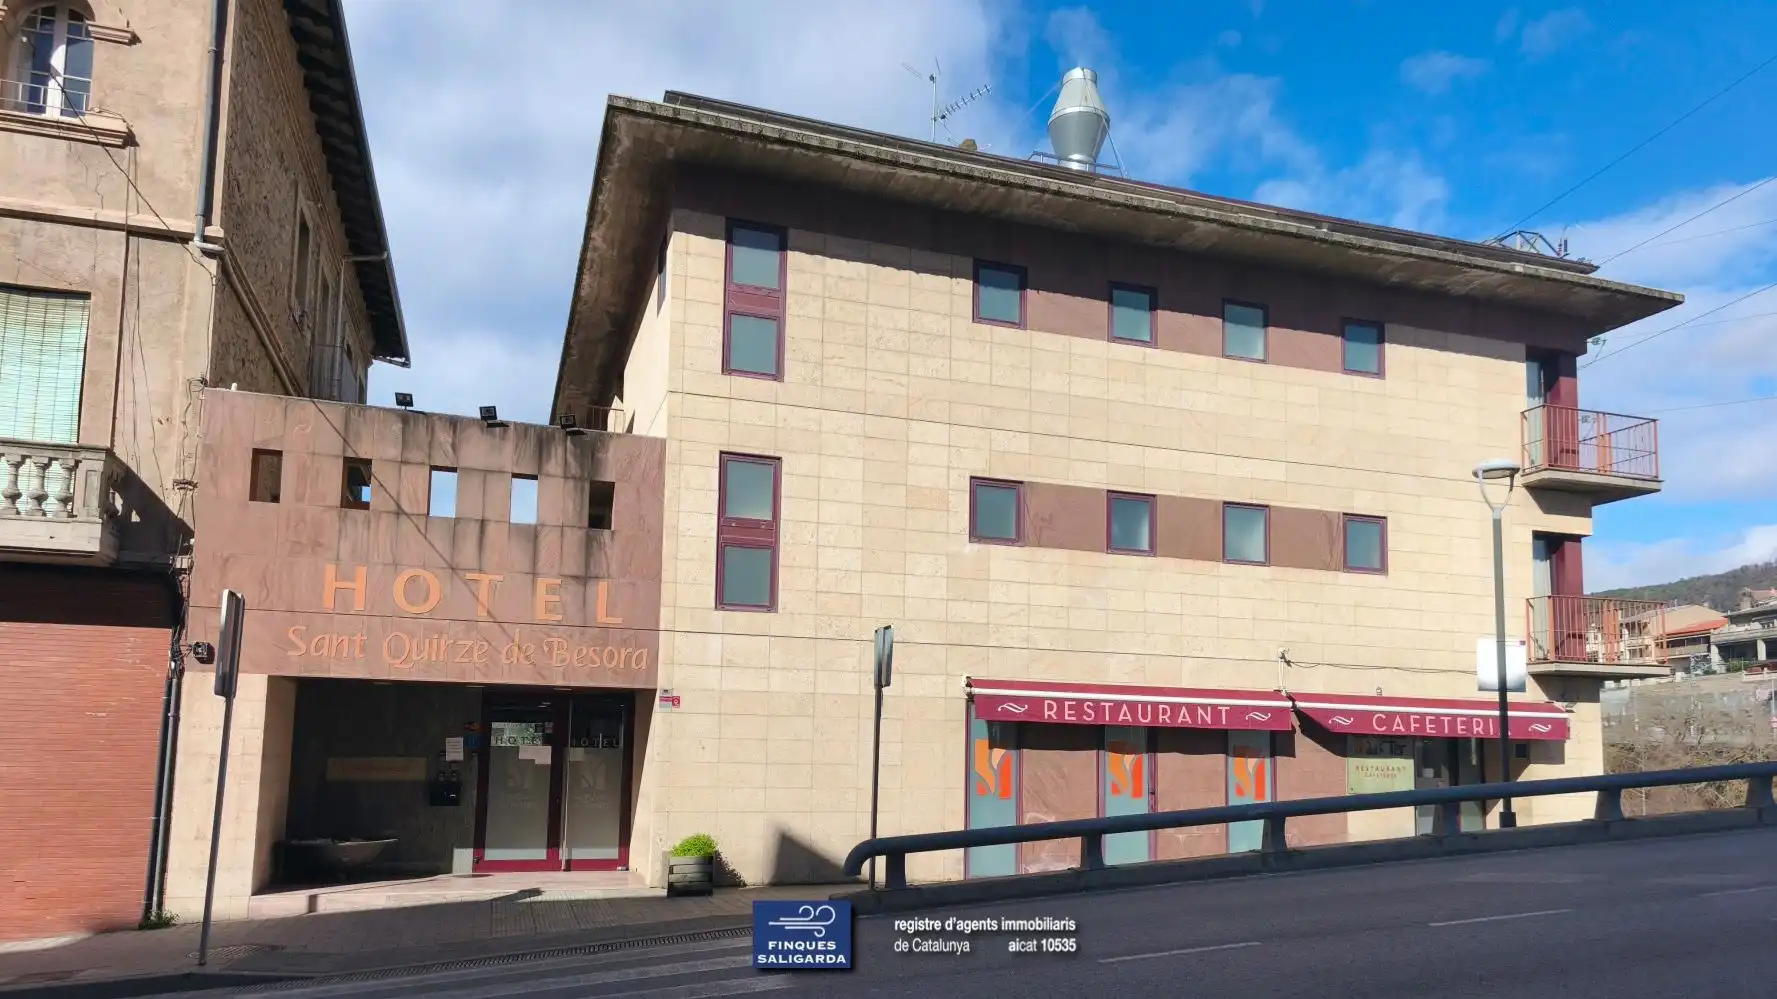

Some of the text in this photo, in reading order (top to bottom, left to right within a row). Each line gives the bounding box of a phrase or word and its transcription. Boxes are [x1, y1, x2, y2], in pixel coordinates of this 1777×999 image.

[323, 564, 624, 625] HOTEL
[286, 626, 649, 671] Sant Quirze de Besora
[1043, 700, 1231, 725] RESTAURANT
[1372, 714, 1512, 736] CAFETERI
